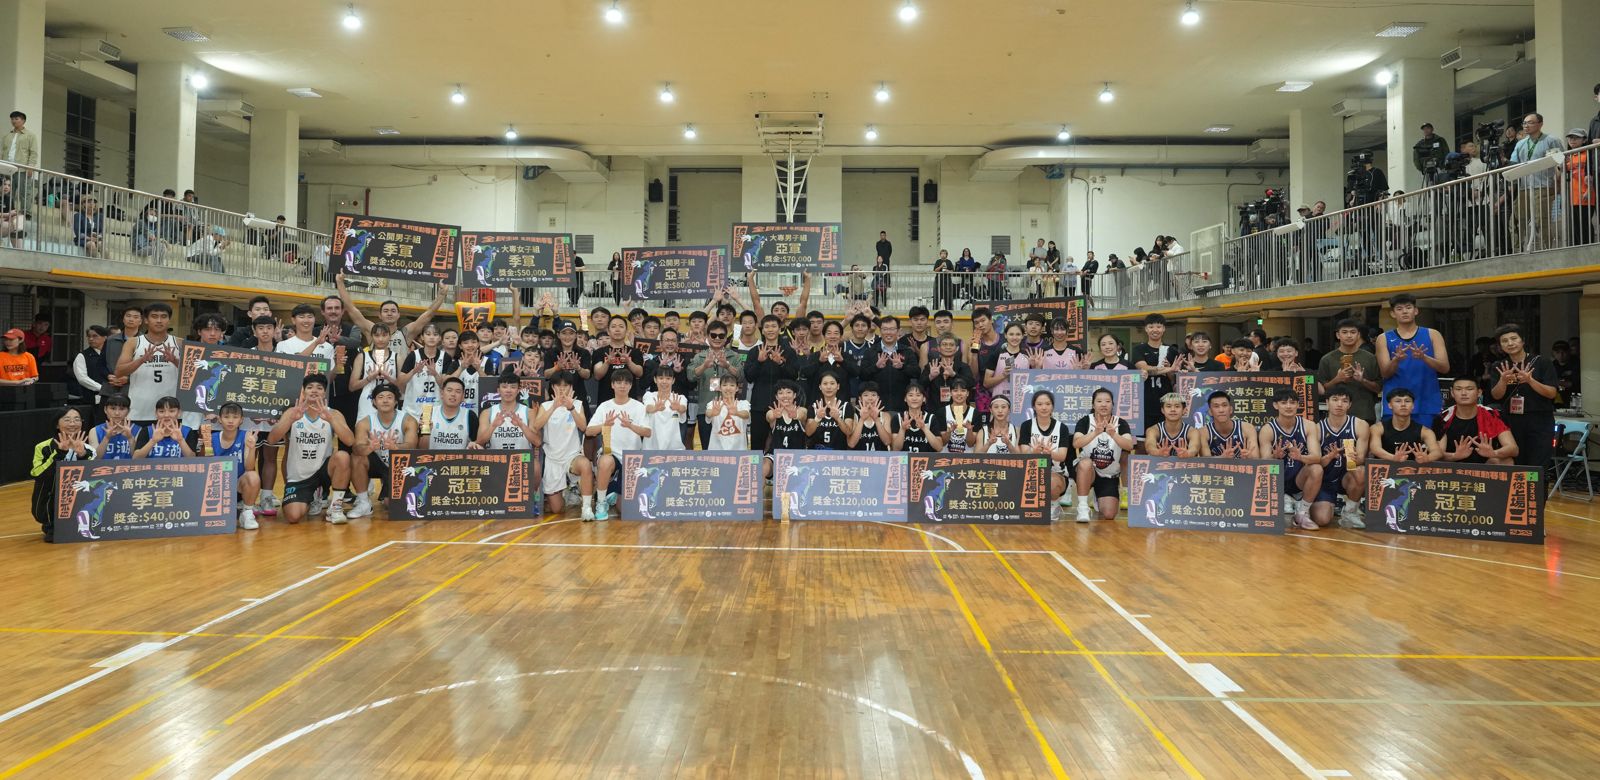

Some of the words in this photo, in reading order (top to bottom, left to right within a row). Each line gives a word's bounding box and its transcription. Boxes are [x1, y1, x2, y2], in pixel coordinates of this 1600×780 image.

[378, 231, 422, 244] 公開男子組
[769, 234, 807, 242] 大專男子組
[383, 242, 413, 258] 季軍
[501, 245, 540, 254] 大專女子組
[775, 243, 801, 254] 亞軍
[369, 256, 423, 270] 獎金:$60,000
[508, 255, 536, 268] 季軍
[658, 258, 696, 267] 公開男子組
[765, 255, 812, 263] 獎金:$70,000
[498, 269, 547, 277] 獎金:$50,000
[664, 269, 690, 280] 亞軍
[655, 281, 700, 290] 獎金:$80,000
[153, 370, 163, 383] 5
[235, 363, 286, 378] 高中男子組
[242, 377, 278, 394] 季軍
[423, 381, 435, 392] 32
[1150, 376, 1162, 388] 14
[464, 388, 475, 399] 88
[1225, 387, 1274, 397] 大專女子組
[226, 391, 290, 407] 獎金:$40,000
[1063, 395, 1094, 410] 亞軍
[1233, 398, 1267, 413] 亞軍
[433, 437, 463, 445] THUNDER
[438, 431, 459, 439] BLACK
[494, 431, 524, 439] THUNDER
[824, 431, 831, 443] 5
[782, 436, 788, 448] 4
[440, 465, 490, 476] 公開男子組
[671, 467, 720, 477] 高中女子組
[821, 466, 870, 477] 公開女子組
[957, 469, 1007, 481] 大專女子組
[122, 476, 184, 490] 高中女子組
[1180, 473, 1234, 487] 大專男子組
[1425, 479, 1486, 493] 高中男子組
[448, 478, 483, 495] 冠軍
[679, 479, 713, 496] 冠軍
[829, 478, 862, 495] 冠軍
[965, 482, 999, 499] 冠軍
[132, 491, 174, 510] 季軍
[431, 495, 499, 506] 獎金:$120,000
[665, 496, 725, 508] 獎金:$70,000
[812, 495, 878, 506] 獎金:$120,000
[1189, 487, 1226, 505] 冠軍
[1435, 493, 1477, 511] 冠軍
[948, 499, 1015, 511] 獎金:$100,000
[1171, 504, 1244, 518] 獎金:$100,000
[113, 510, 190, 525] 獎金:$40,000
[1418, 511, 1494, 526] 獎金:$70,000
